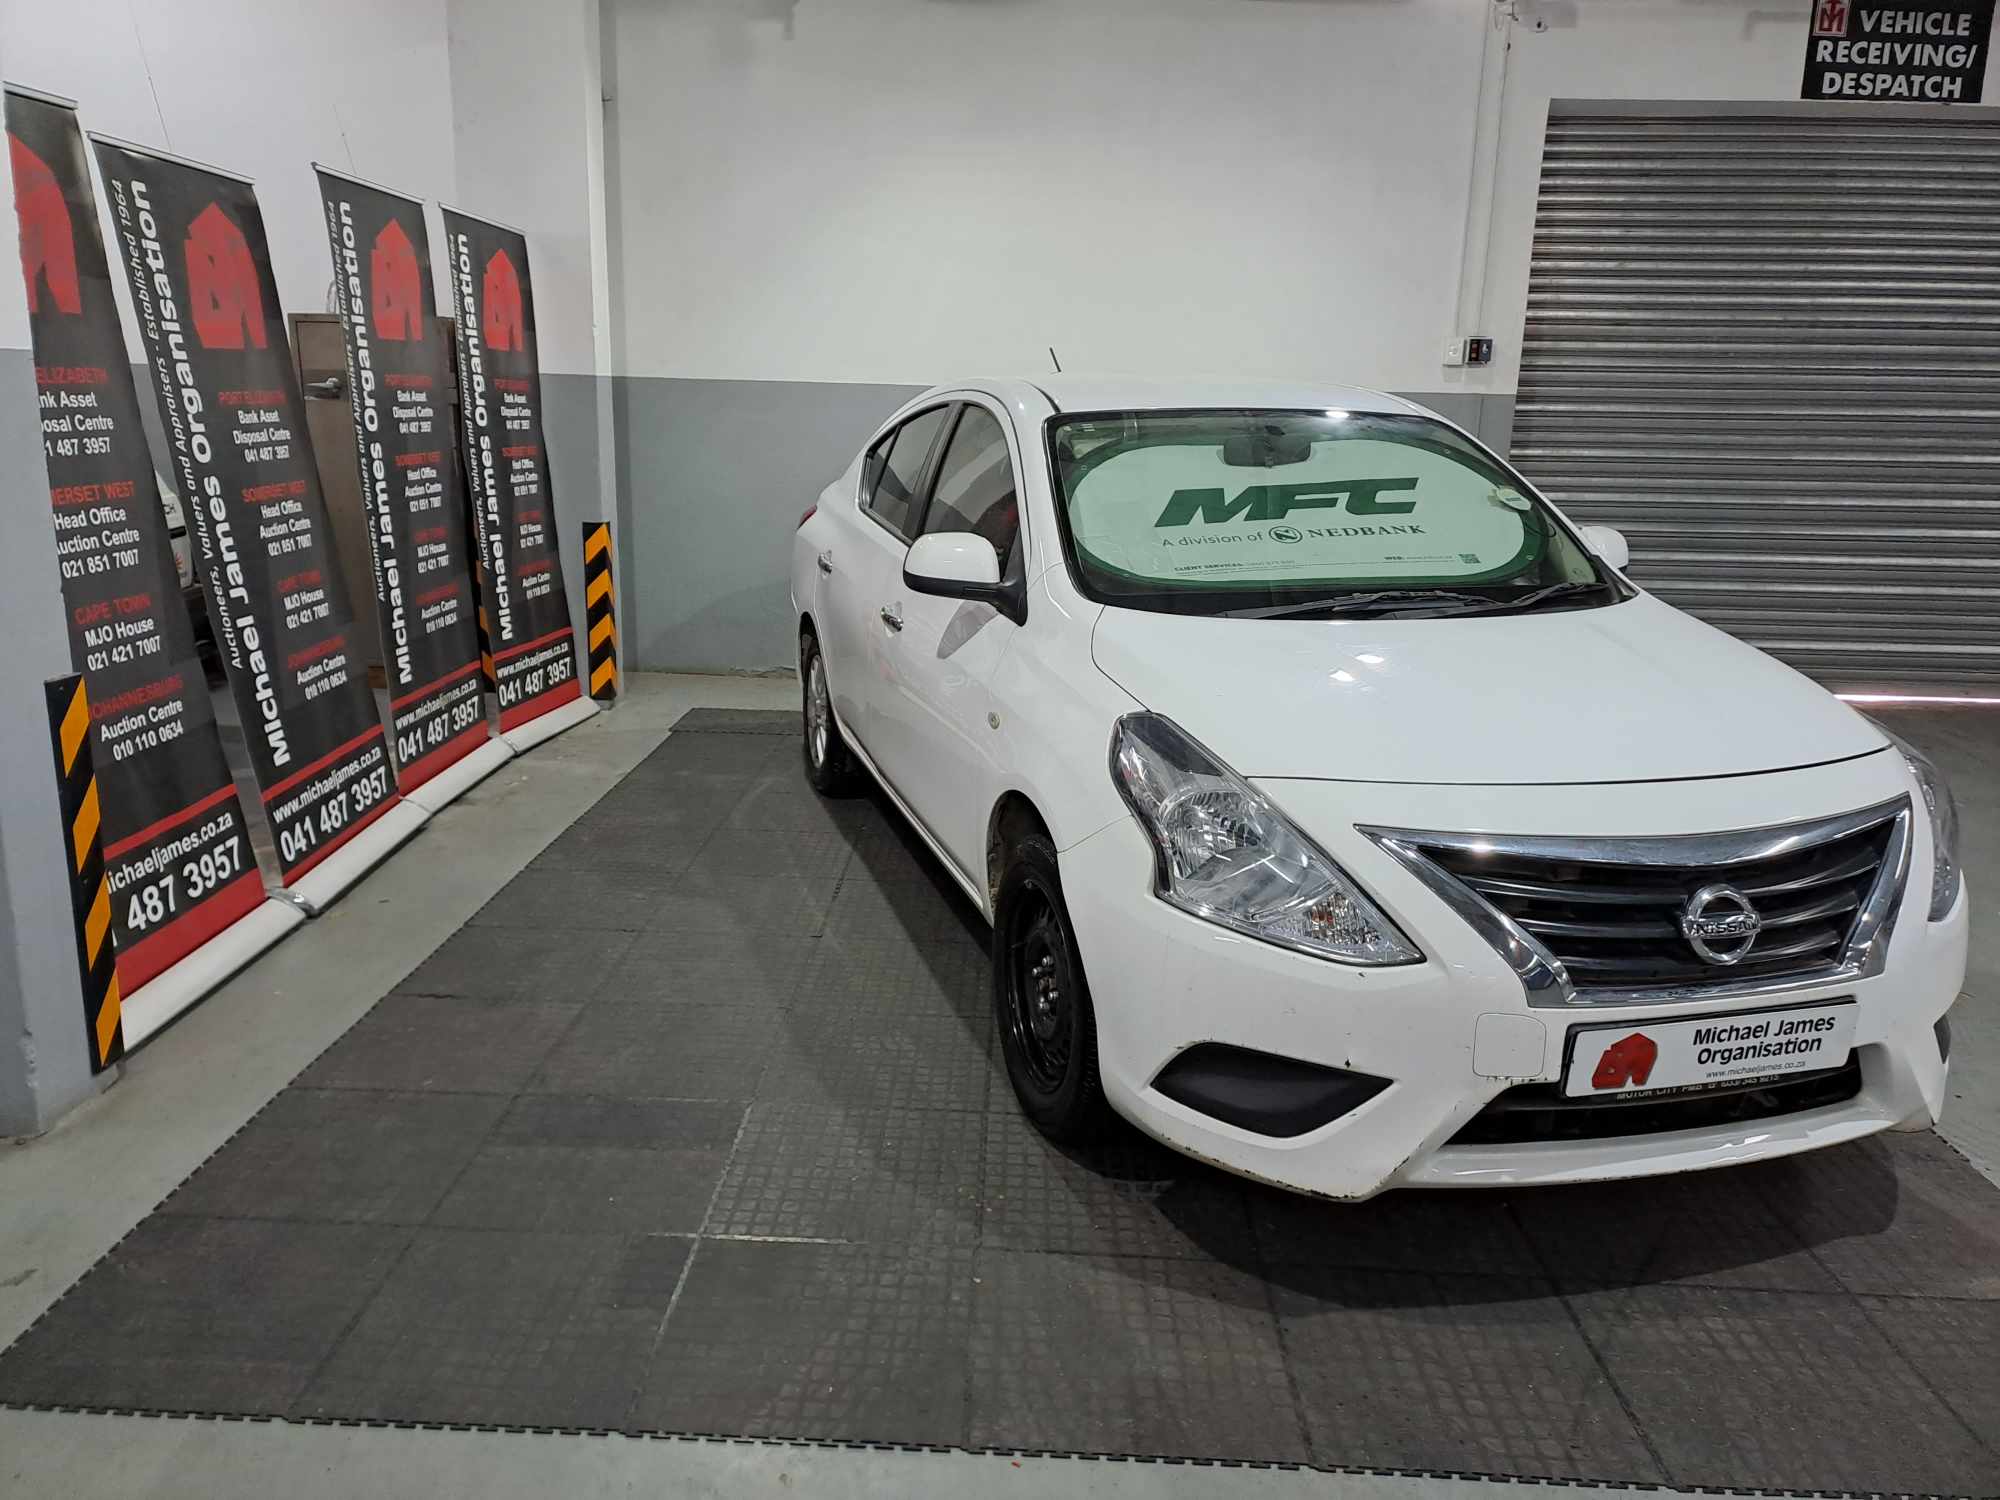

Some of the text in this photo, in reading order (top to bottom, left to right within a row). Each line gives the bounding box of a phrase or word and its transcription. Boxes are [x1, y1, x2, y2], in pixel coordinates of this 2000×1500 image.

[1860, 10, 1972, 36] VEHICLE
[1816, 40, 1978, 68] RECEIVING/
[1822, 71, 1962, 98] DESPATCH
[111, 179, 132, 227] 1964
[122, 231, 160, 341] Established
[39, 391, 98, 408] nk Asset
[156, 356, 188, 453] Appraisers
[41, 414, 114, 432] osal Centre
[233, 428, 269, 446] Disposal
[457, 233, 513, 640] Michael James Organisation
[57, 438, 79, 456] 487
[83, 437, 111, 454] 3957
[339, 202, 413, 685] Michael James Organisation
[130, 180, 292, 768] Michael James Organisation
[178, 455, 197, 491] and
[260, 503, 280, 519] Head
[1154, 477, 1419, 527] MFC
[53, 506, 127, 530] Head Office
[260, 522, 288, 539] Auction
[102, 528, 140, 549] Centre
[1162, 524, 1427, 548] A division of NEDBANK
[61, 549, 139, 578] 021 851 7007
[84, 617, 154, 648] MJO House
[209, 566, 243, 670] Auctioneers,
[87, 635, 161, 672] 021 421 7007
[297, 664, 324, 685] Auction
[498, 656, 571, 706] 041 487 3957
[101, 700, 184, 742] Auction Centre
[398, 696, 478, 762] 041 487 3957
[112, 719, 184, 761] 010 110 0634
[273, 746, 382, 824] www.michaeljames.co.za
[280, 765, 387, 862] 041 487 3957
[127, 835, 241, 931] 487 3957
[1693, 1016, 1836, 1046] Michael James
[1697, 1037, 1822, 1065] Organisation
[1705, 1061, 1806, 1079] www.michaeljames.co.za
